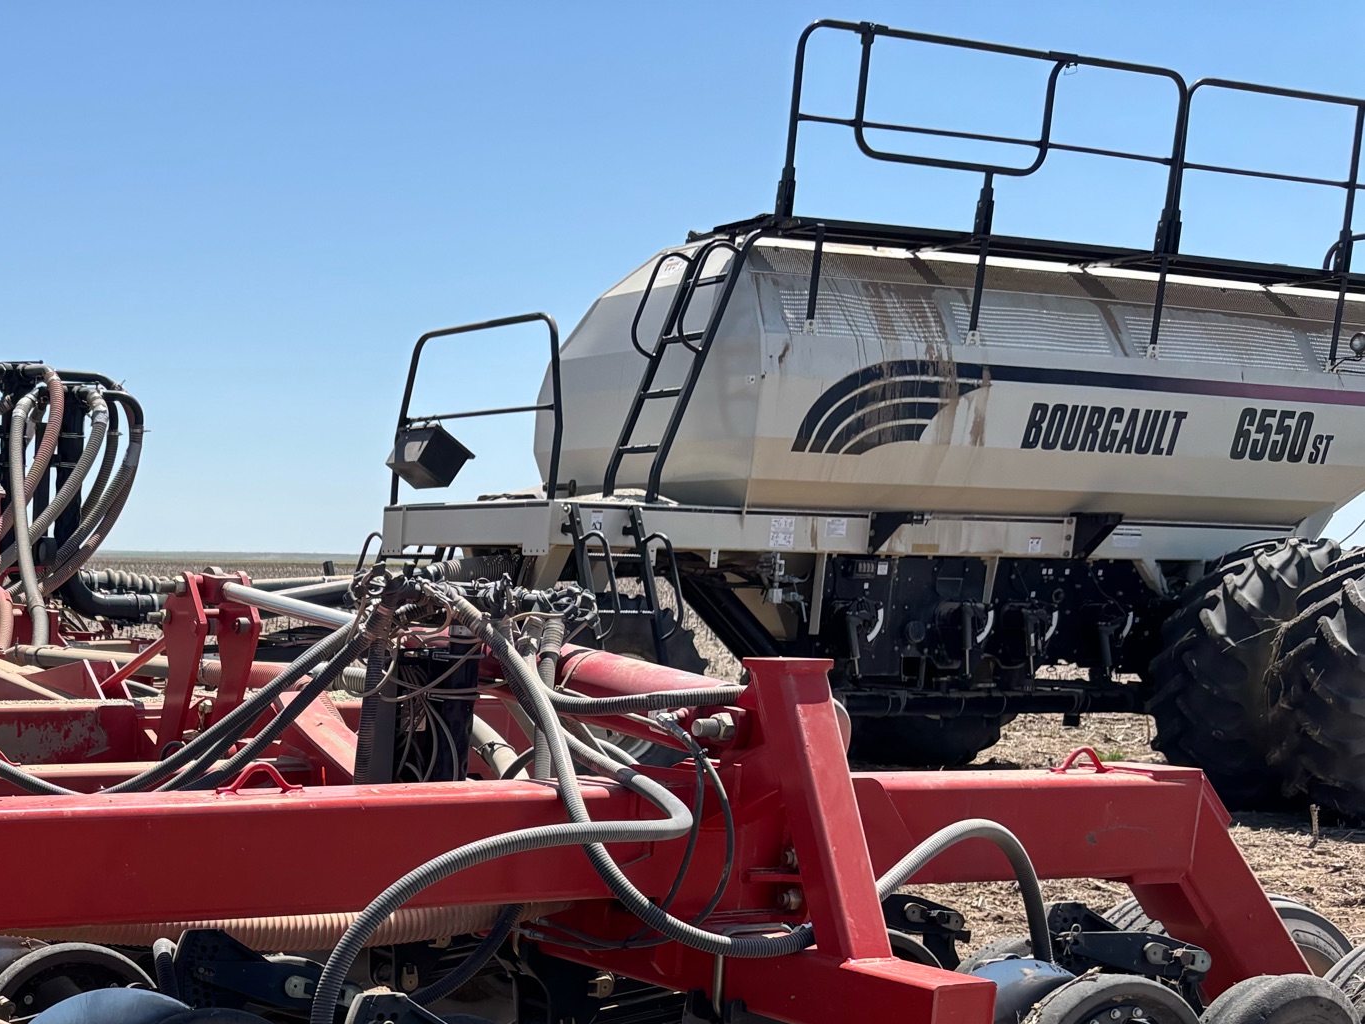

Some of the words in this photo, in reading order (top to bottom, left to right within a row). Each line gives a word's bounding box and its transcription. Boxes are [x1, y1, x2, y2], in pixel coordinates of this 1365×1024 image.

[1020, 402, 1188, 456] BOURGAULT
[1229, 407, 1315, 463] 6550
[1308, 434, 1334, 464] ST
